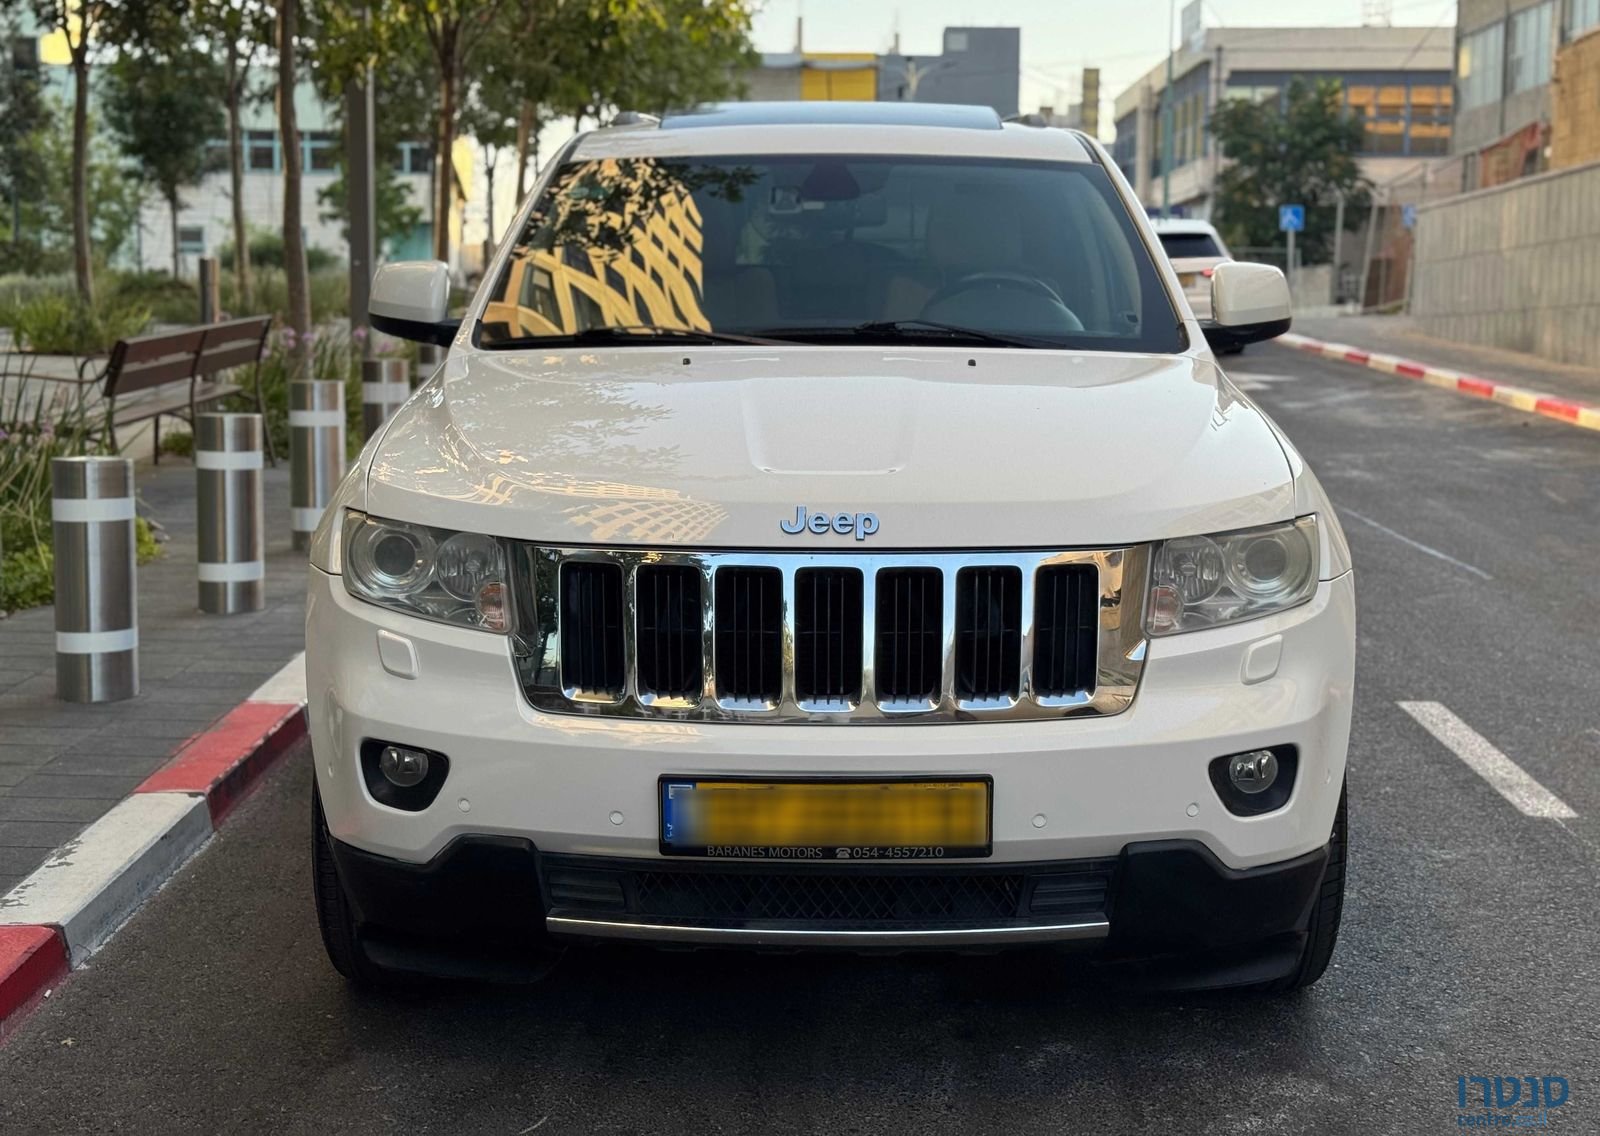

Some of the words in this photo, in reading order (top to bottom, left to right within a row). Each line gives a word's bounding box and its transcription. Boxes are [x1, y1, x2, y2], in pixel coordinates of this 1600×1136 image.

[780, 505, 880, 541] Jeep
[707, 845, 766, 858] BARANES
[768, 847, 823, 859] MOTORS
[853, 846, 944, 858] 054-4557210
